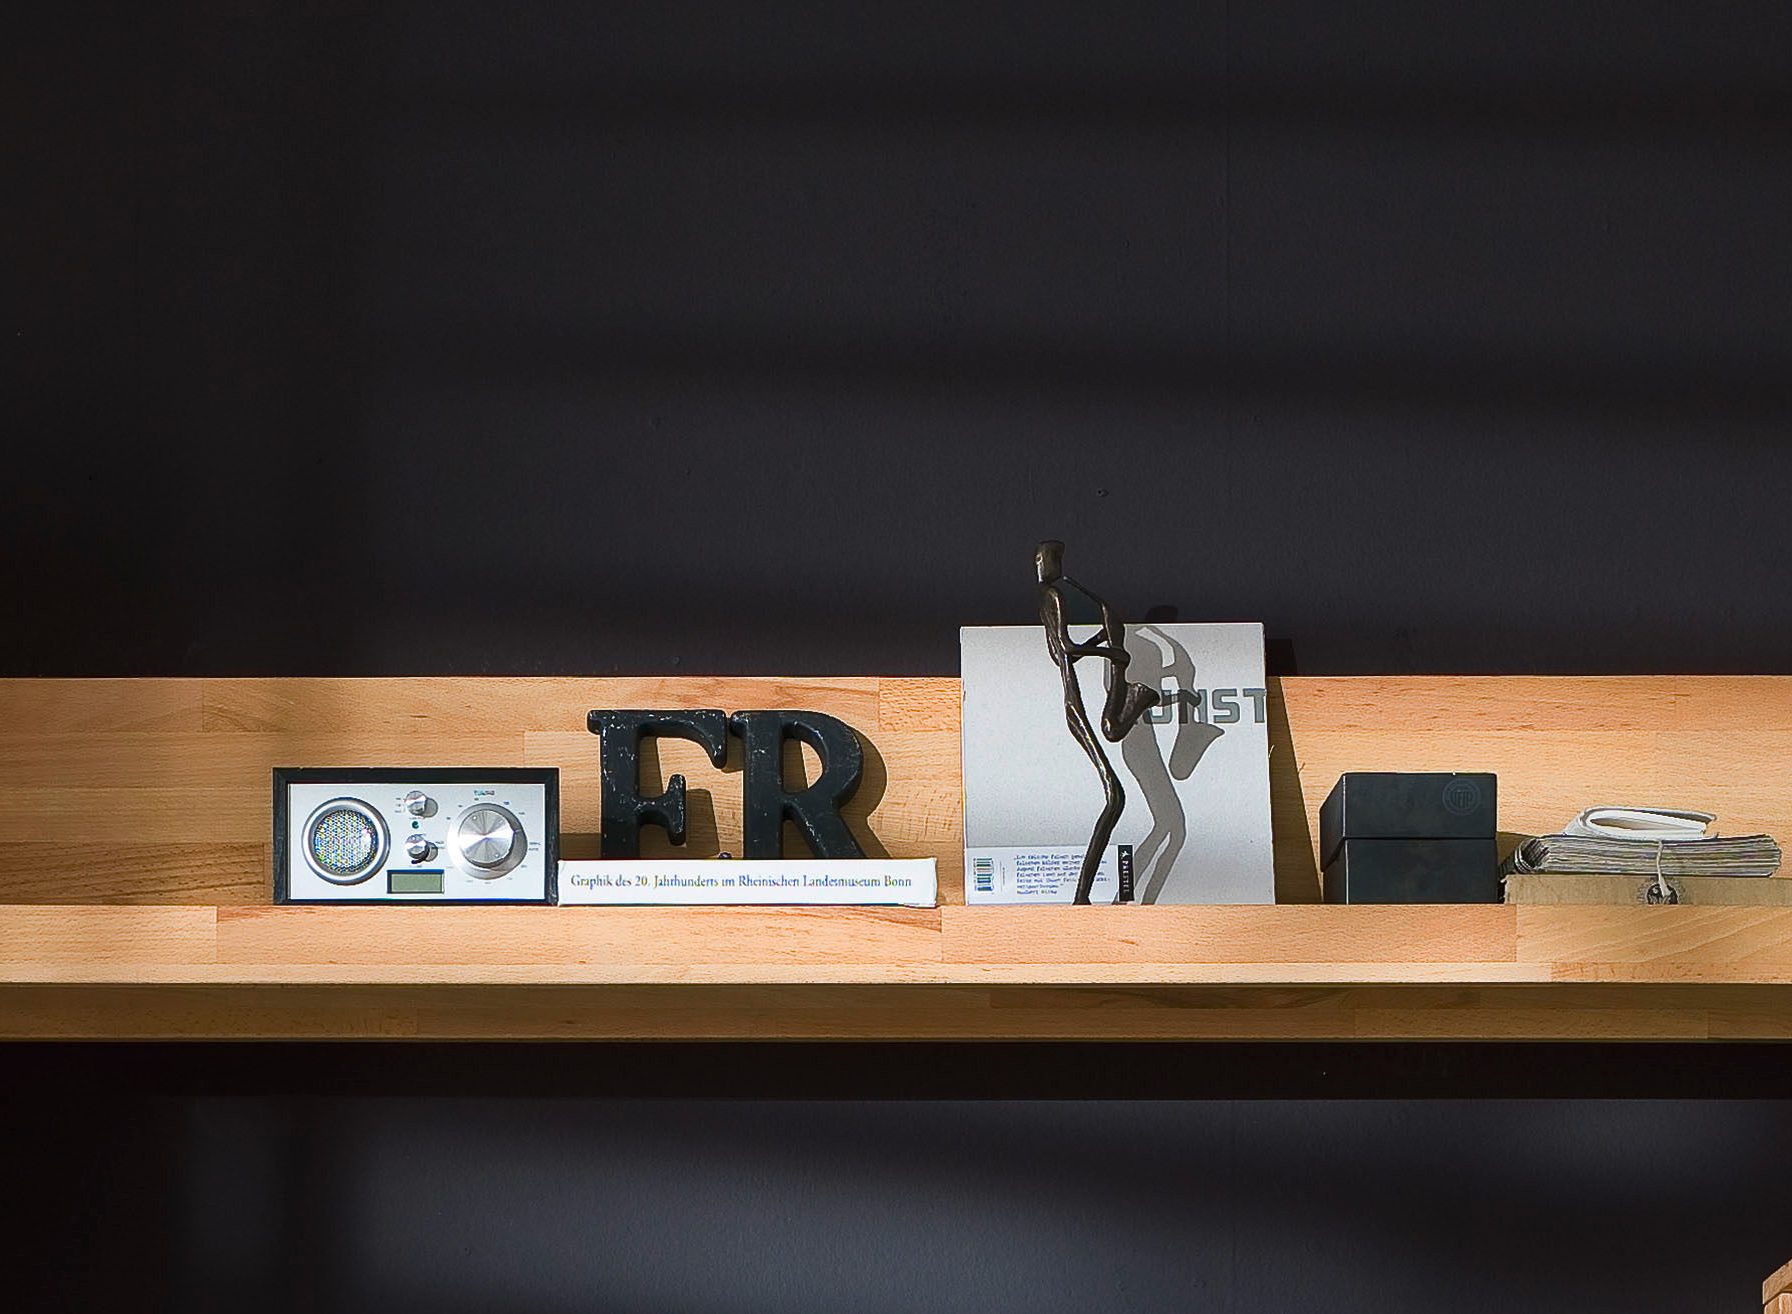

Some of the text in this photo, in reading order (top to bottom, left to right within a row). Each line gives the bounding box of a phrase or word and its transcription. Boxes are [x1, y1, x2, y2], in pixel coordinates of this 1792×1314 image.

[1143, 688, 1266, 724] UNST
[571, 874, 912, 888] Graphik des 20. Jahrhunderts im Rheinischen Landesmuseum Bonn
